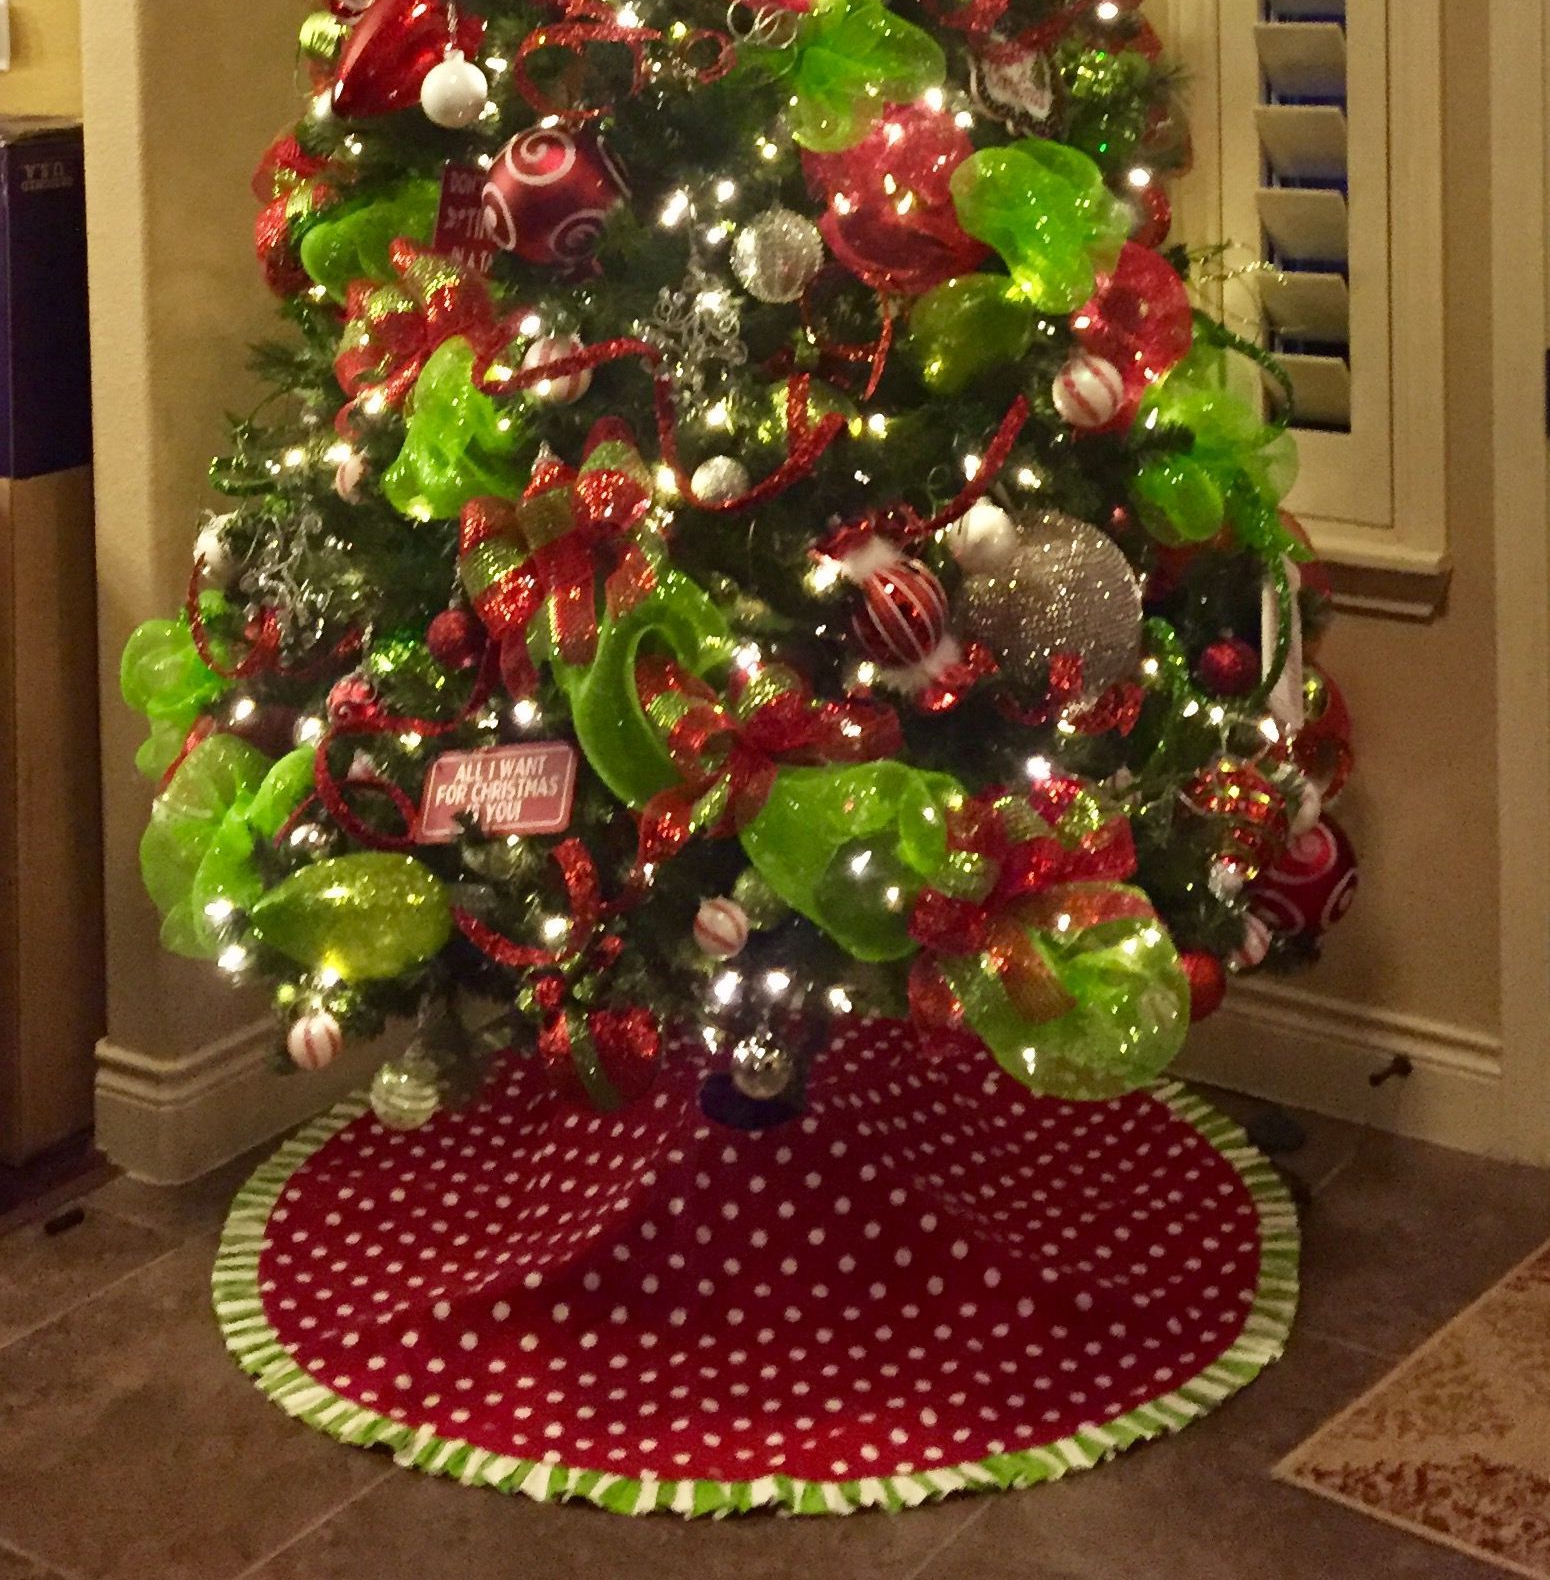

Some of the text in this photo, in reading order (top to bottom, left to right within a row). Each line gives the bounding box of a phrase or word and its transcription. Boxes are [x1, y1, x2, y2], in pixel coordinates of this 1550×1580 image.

[453, 755, 548, 785] ALL I WANT
[435, 774, 560, 807] FOR CHRISTMAS
